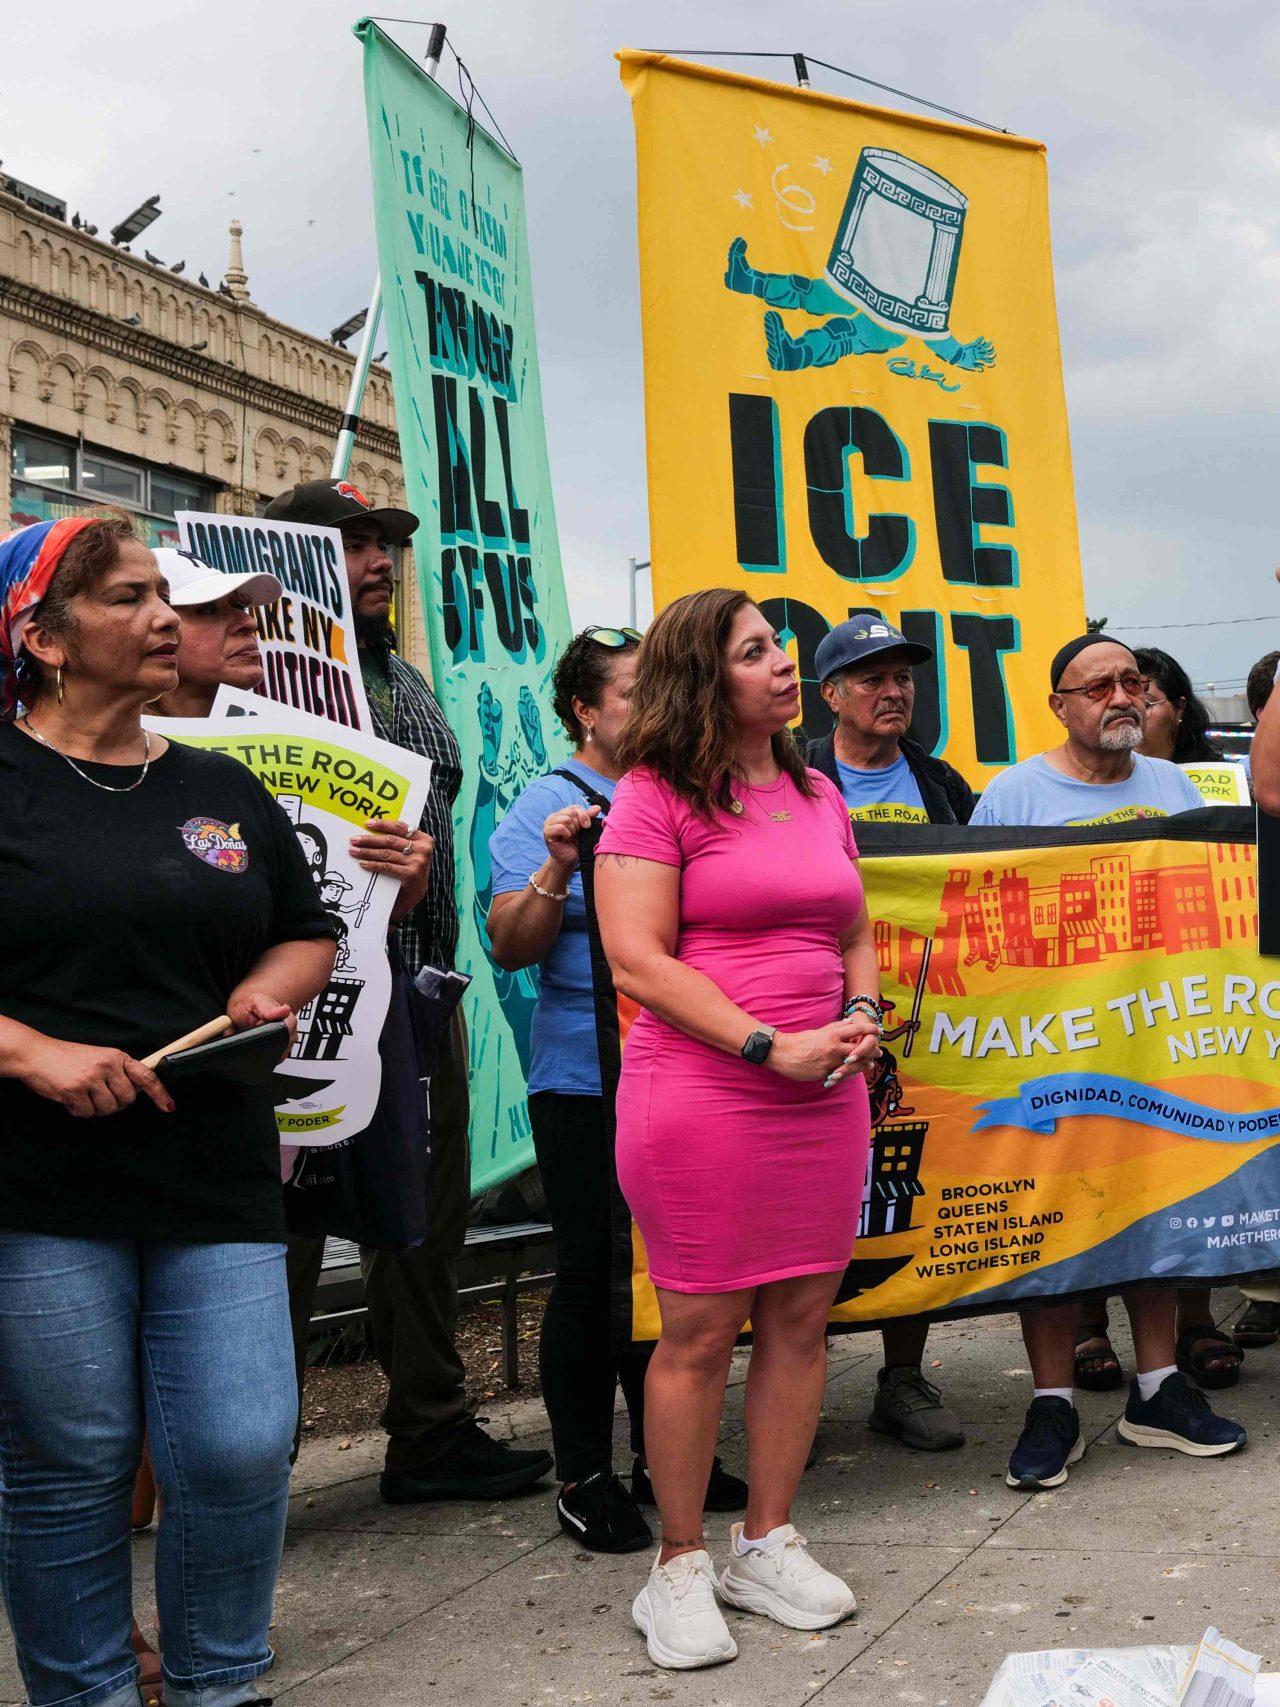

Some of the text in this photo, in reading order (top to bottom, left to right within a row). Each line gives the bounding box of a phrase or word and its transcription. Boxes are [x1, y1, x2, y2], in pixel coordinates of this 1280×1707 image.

[729, 392, 1020, 587] ICE
[187, 522, 344, 620] IMMIGRANTS
[250, 596, 334, 660] AKE NY
[237, 744, 399, 801] THE ROAD
[1189, 773, 1231, 785] OAD
[260, 771, 391, 820] NEW YORK
[1199, 785, 1231, 796] ORK
[866, 808, 891, 820] THE
[1114, 808, 1137, 820] THE
[183, 833, 247, 851] Las Doñas
[929, 1007, 1099, 1059] MAKE
[1106, 975, 1212, 1036] THE
[1167, 1026, 1252, 1063] NEW
[288, 1115, 330, 1127] PODER
[1030, 1087, 1125, 1111] DIGNIDAD,
[1128, 1094, 1224, 1132] COMUNIDAD
[1227, 1120, 1235, 1132] Y
[942, 1178, 1036, 1201] BROOKLYN
[937, 1200, 1009, 1220] QUEENS
[934, 1211, 1064, 1239] STATEN ISLAND
[930, 1232, 1045, 1259] LONG ISLAND
[915, 1250, 1041, 1279] WESTCHESTER
